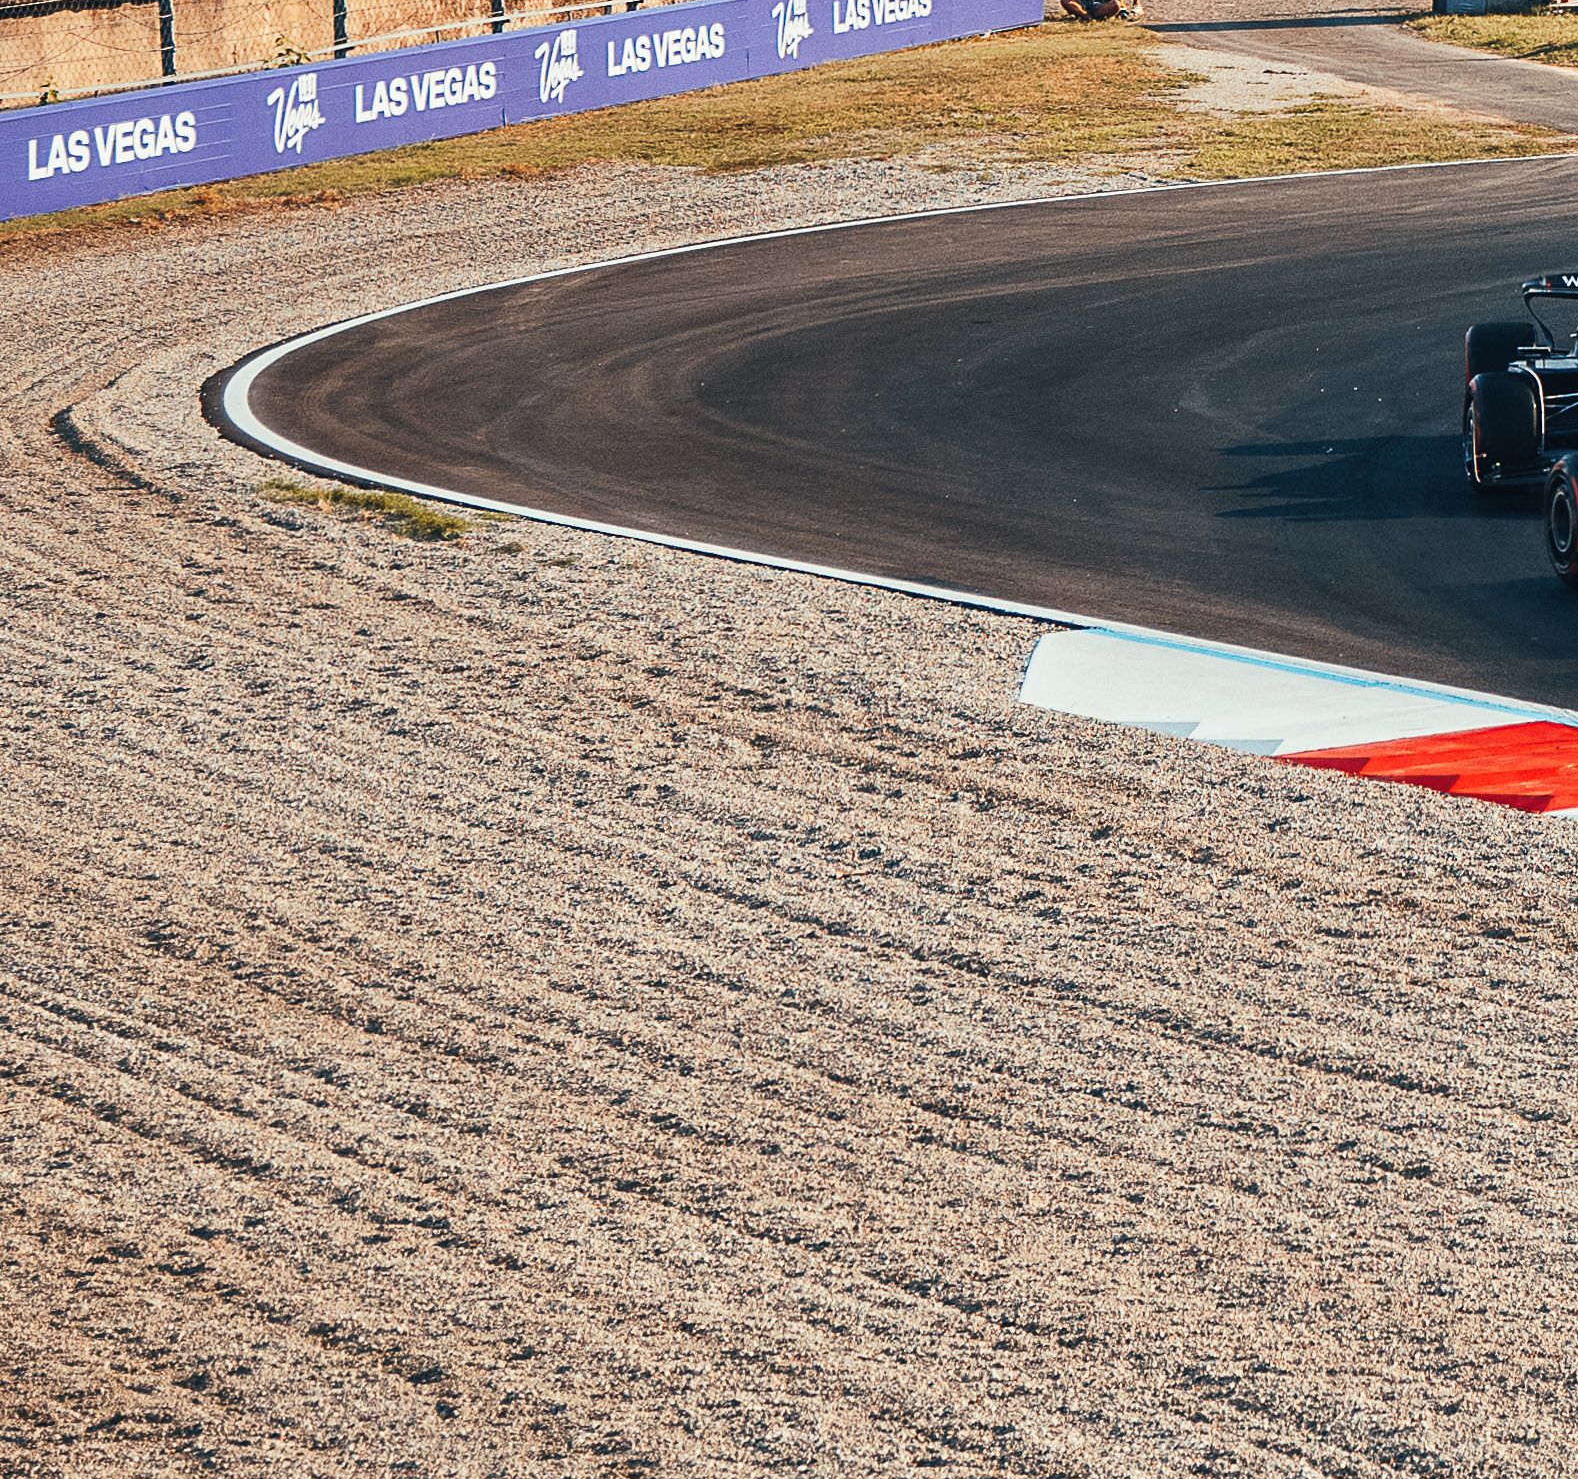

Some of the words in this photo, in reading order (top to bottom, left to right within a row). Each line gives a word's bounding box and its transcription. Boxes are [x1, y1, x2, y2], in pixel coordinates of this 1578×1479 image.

[608, 35, 651, 76] LAS
[653, 23, 725, 66] VEGAS
[356, 75, 408, 123] LAS
[408, 61, 497, 112] VEGAS
[28, 130, 90, 180] LAS
[93, 110, 197, 166] VEGAS
